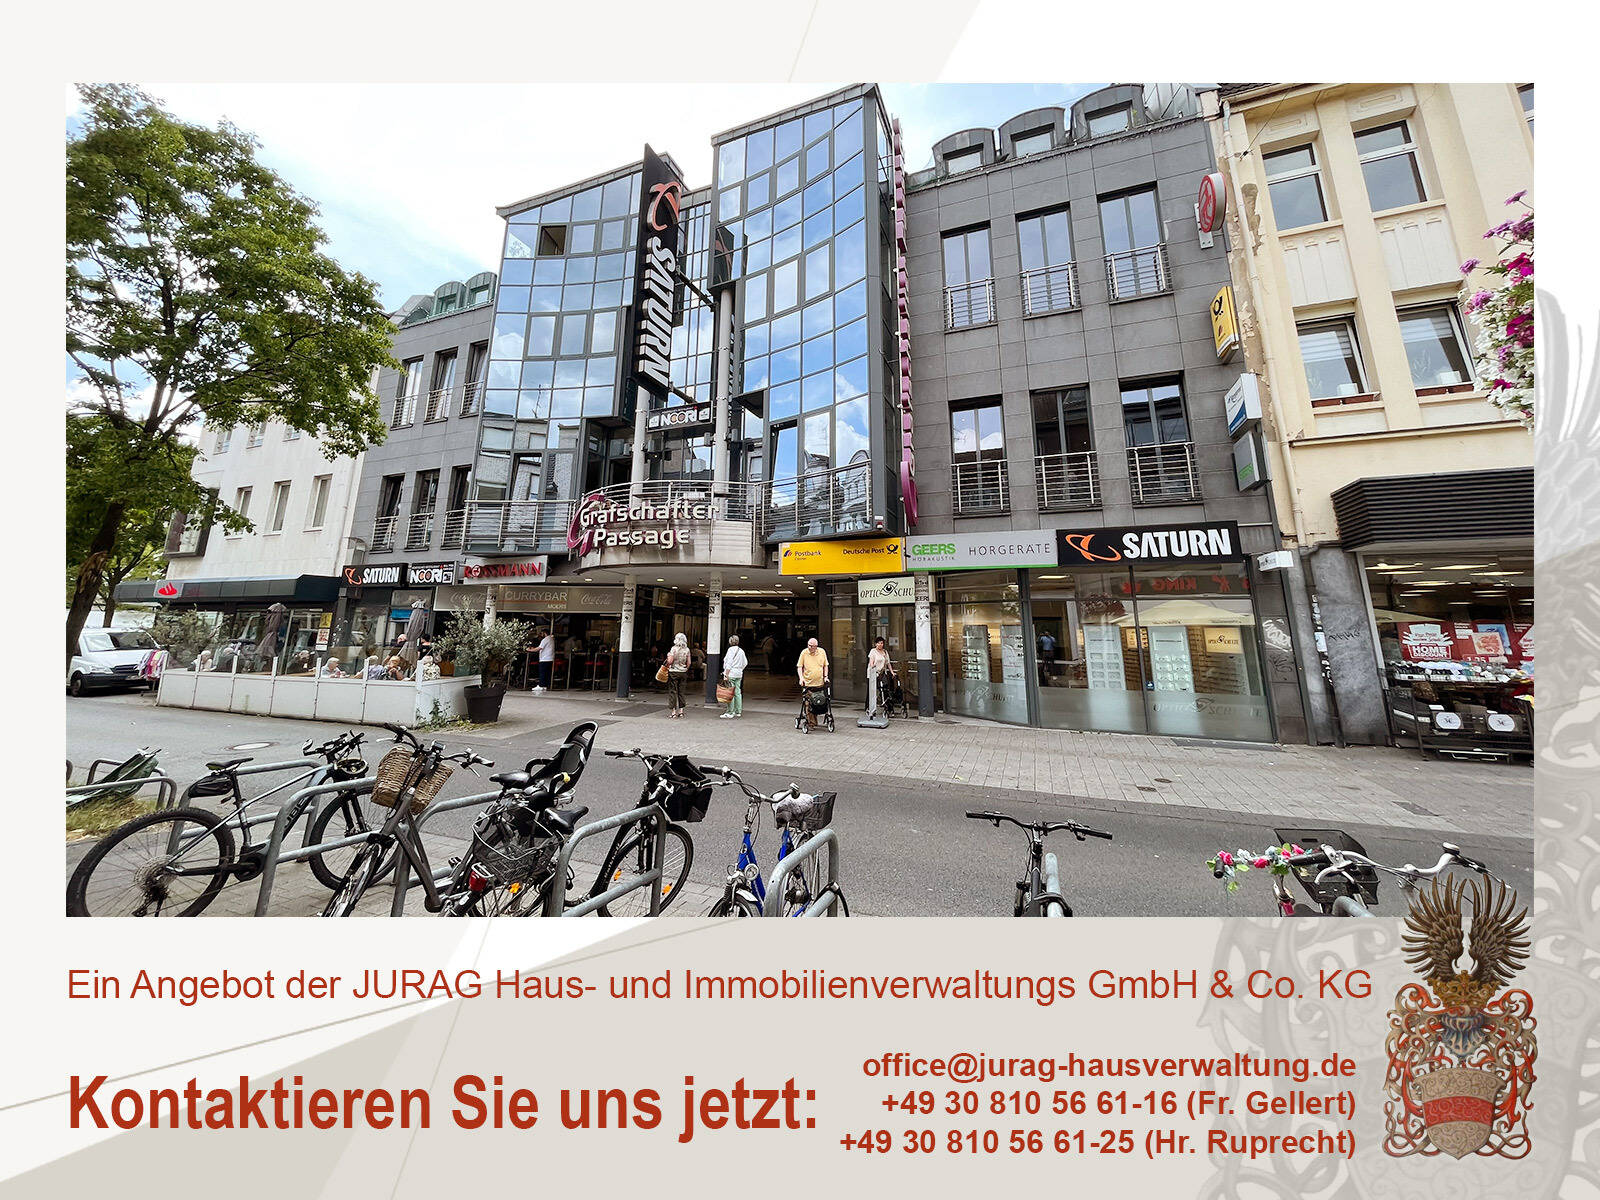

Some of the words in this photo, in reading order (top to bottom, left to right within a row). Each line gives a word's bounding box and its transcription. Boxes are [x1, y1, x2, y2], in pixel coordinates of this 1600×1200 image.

[639, 236, 676, 388] SATURN
[661, 407, 698, 427] NOORI
[580, 499, 720, 528] Grafschafter
[593, 529, 690, 549] Passage
[1121, 528, 1233, 559] SATURN
[911, 543, 956, 556] GEERS
[363, 566, 399, 584] SATURN
[410, 564, 444, 584] NOORI
[464, 562, 543, 579] ROSSMANN
[504, 591, 568, 601] CURRYBAR
[860, 589, 881, 599] OPTIC
[893, 587, 914, 597] SCHU
